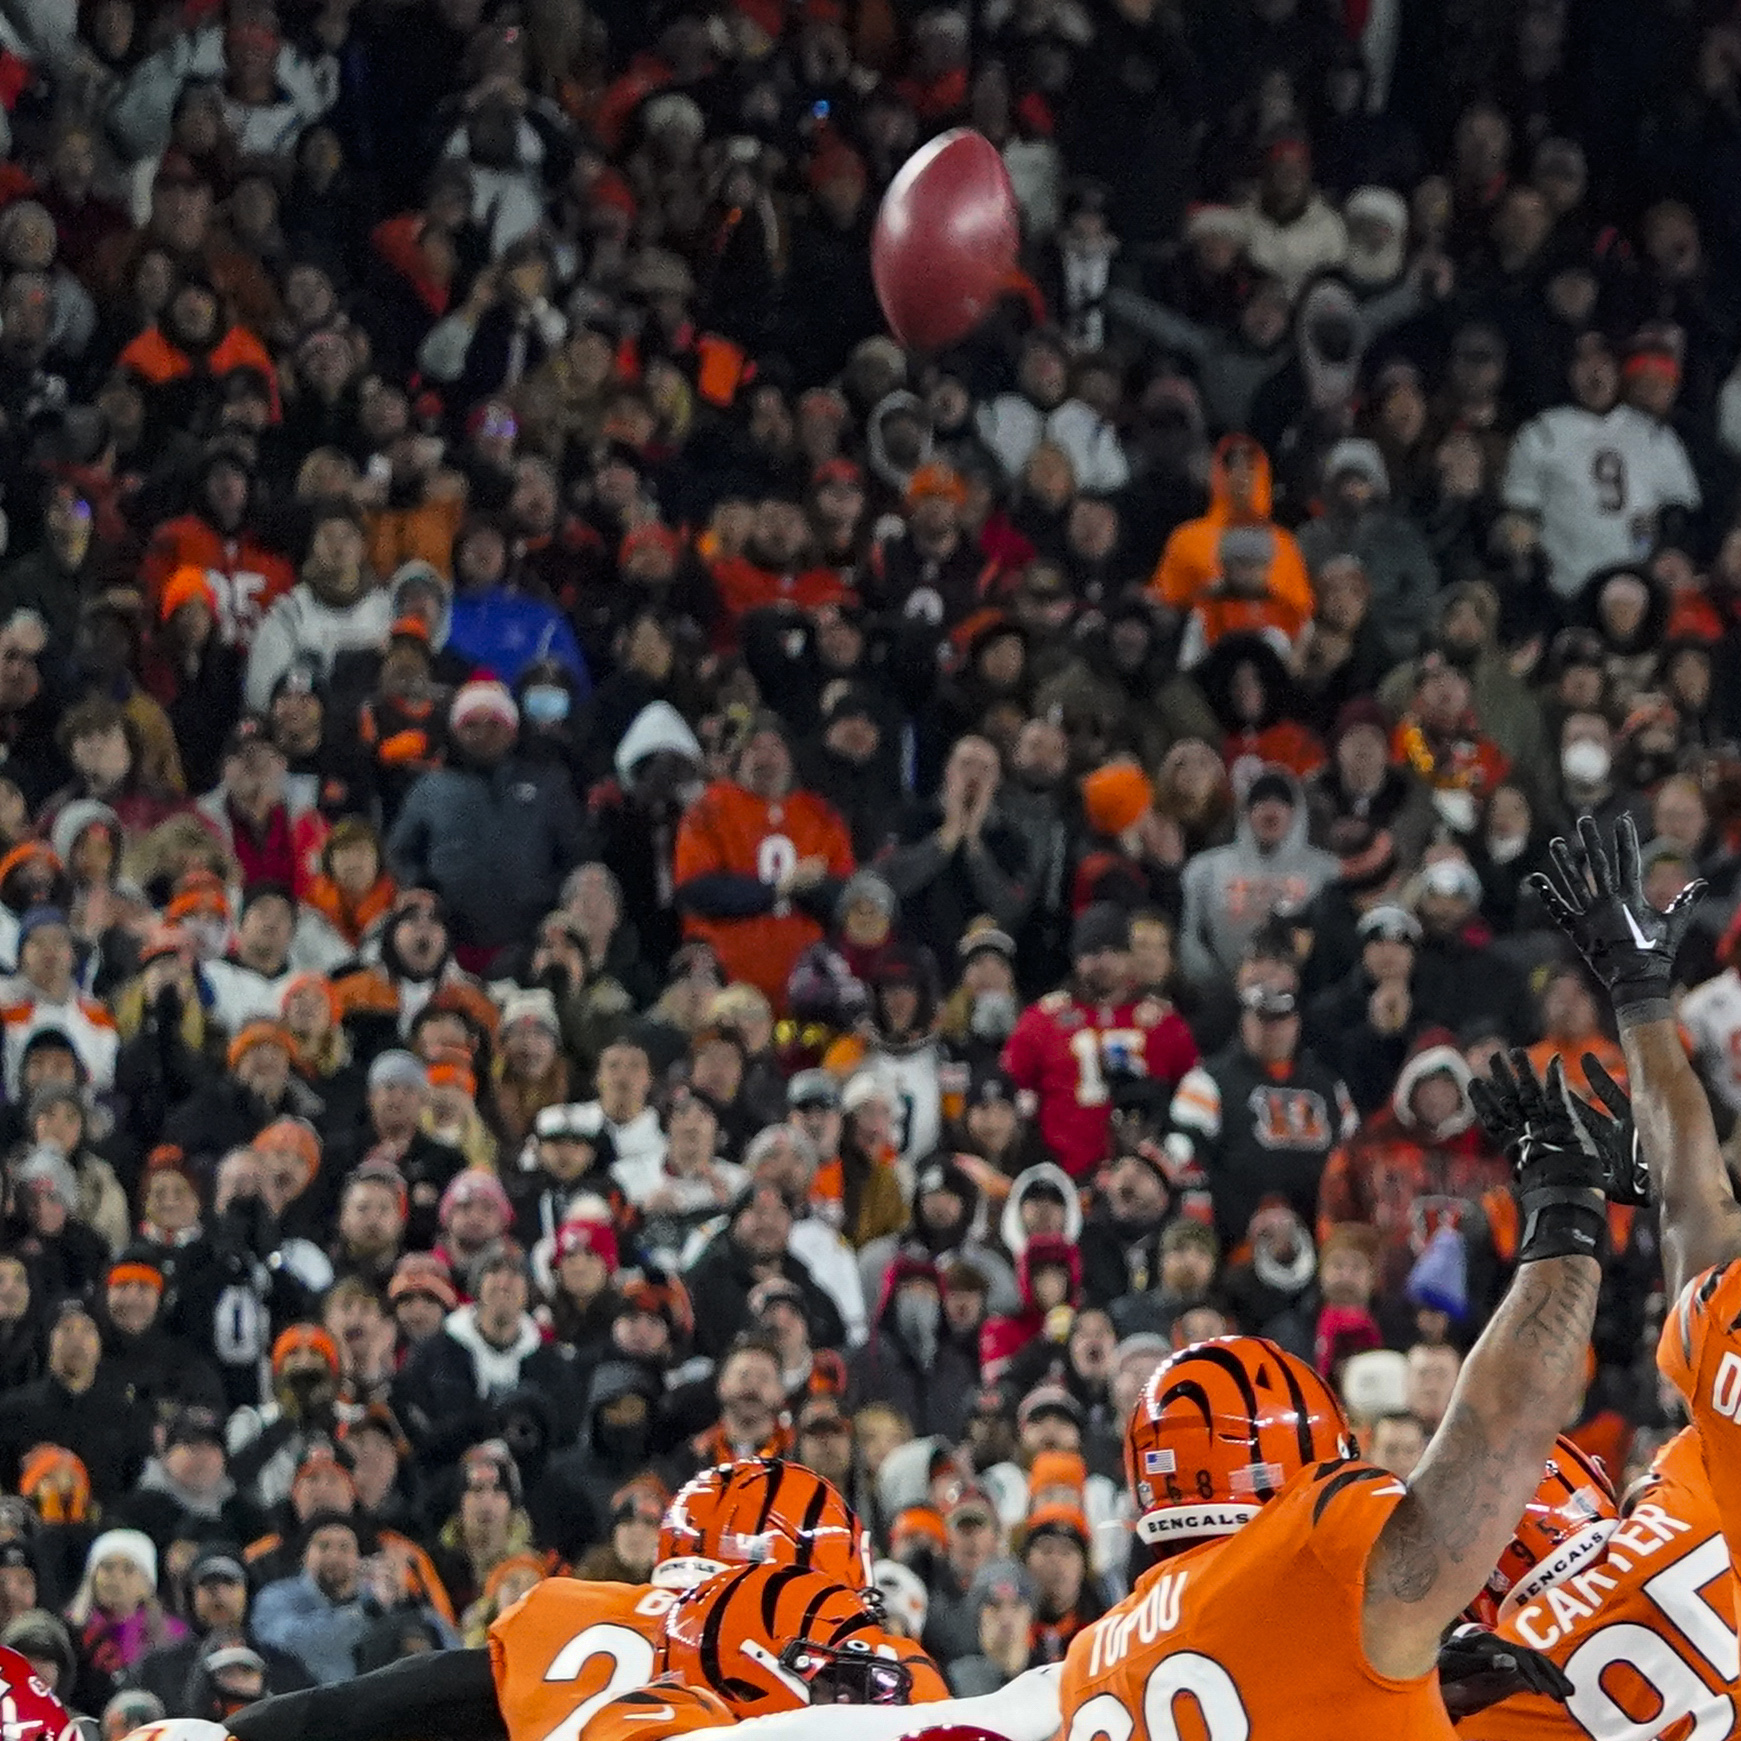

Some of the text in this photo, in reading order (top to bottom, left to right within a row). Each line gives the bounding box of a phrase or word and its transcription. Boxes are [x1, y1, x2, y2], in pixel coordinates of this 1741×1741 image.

[1593, 448, 1628, 512] 9
[1148, 1512, 1251, 1534] BENGALS
[1515, 1529, 1605, 1605] BENGALS
[1088, 1570, 1189, 1678] TUPOU
